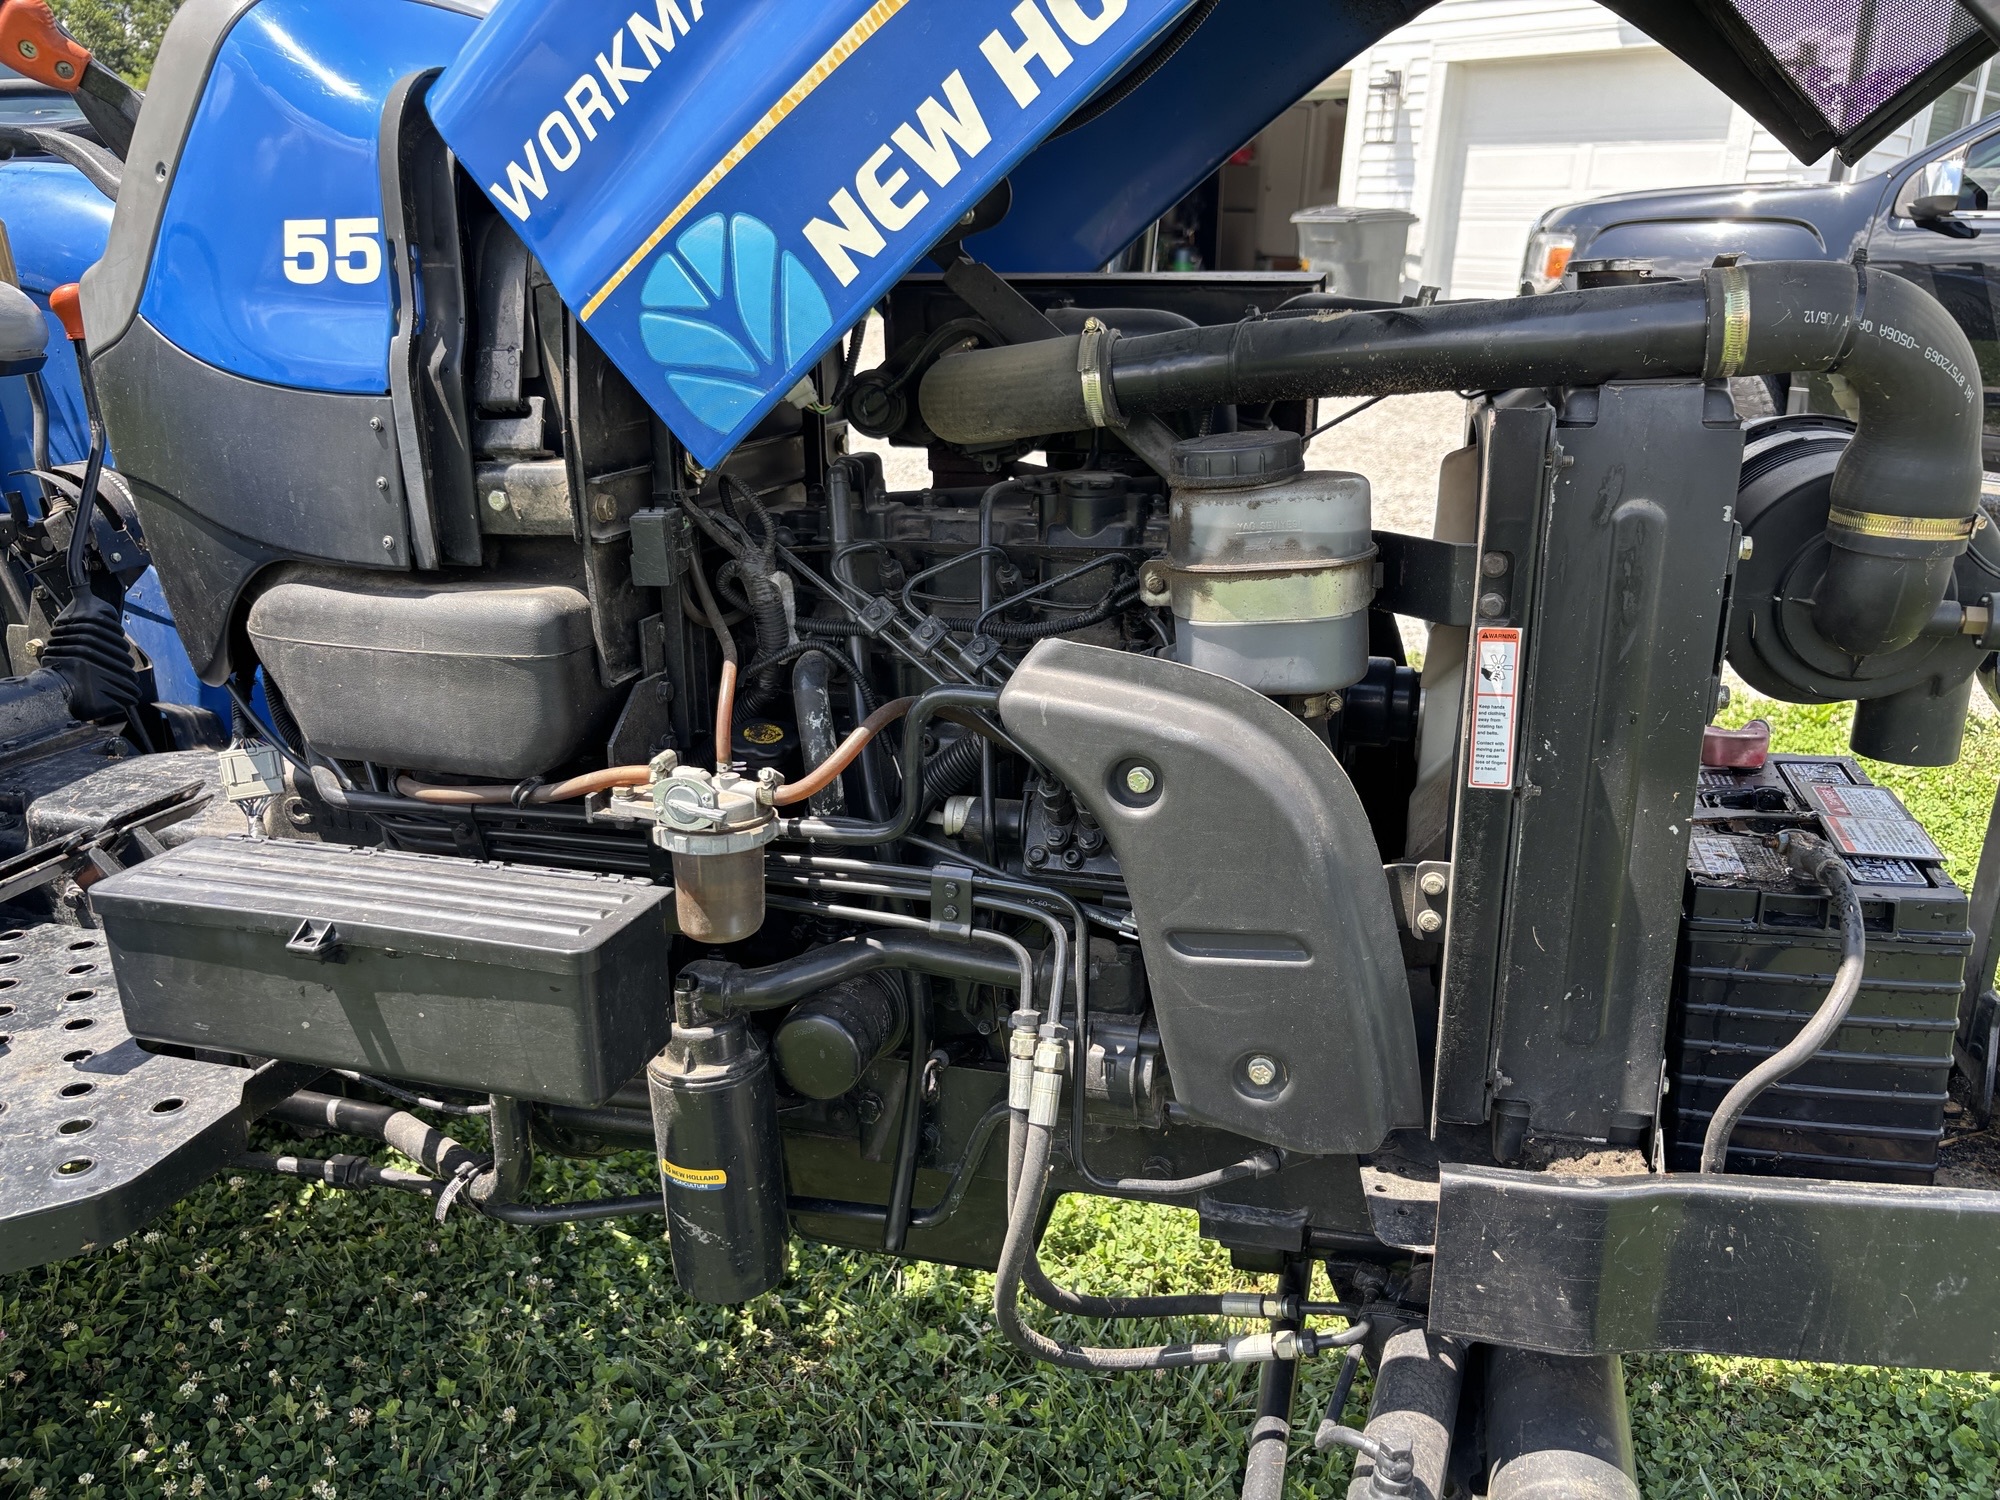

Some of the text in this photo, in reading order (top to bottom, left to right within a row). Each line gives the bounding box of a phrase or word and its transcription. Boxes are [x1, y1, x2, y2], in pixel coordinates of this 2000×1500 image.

[489, 0, 704, 222] WORKM
[802, 68, 992, 288] NEW
[283, 217, 382, 285] 55
[1924, 346, 1966, 387] 87572069
[671, 1169, 685, 1178] NEW
